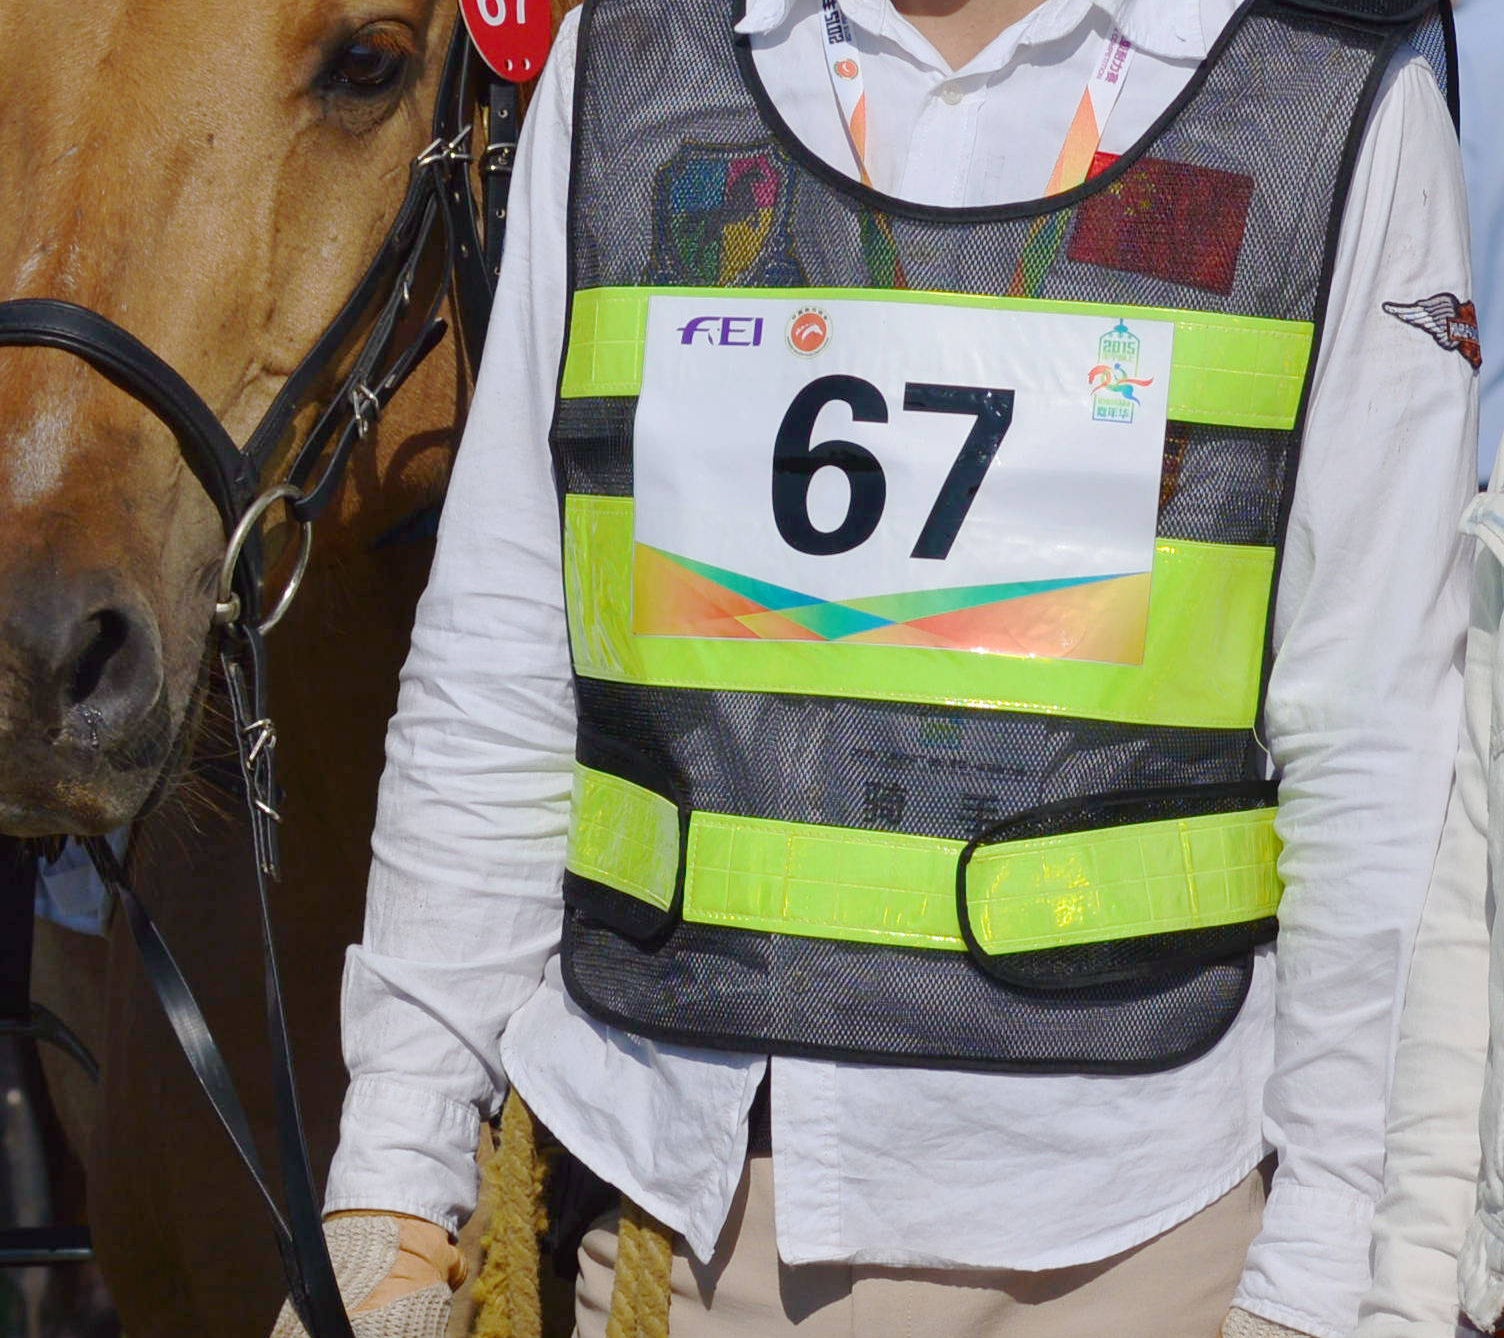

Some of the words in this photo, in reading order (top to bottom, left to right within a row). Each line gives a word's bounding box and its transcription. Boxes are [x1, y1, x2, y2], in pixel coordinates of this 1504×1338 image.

[824, 10, 844, 45] 2015
[676, 316, 764, 347] FEI
[1102, 339, 1136, 355] 2015
[770, 373, 1016, 561] 67
